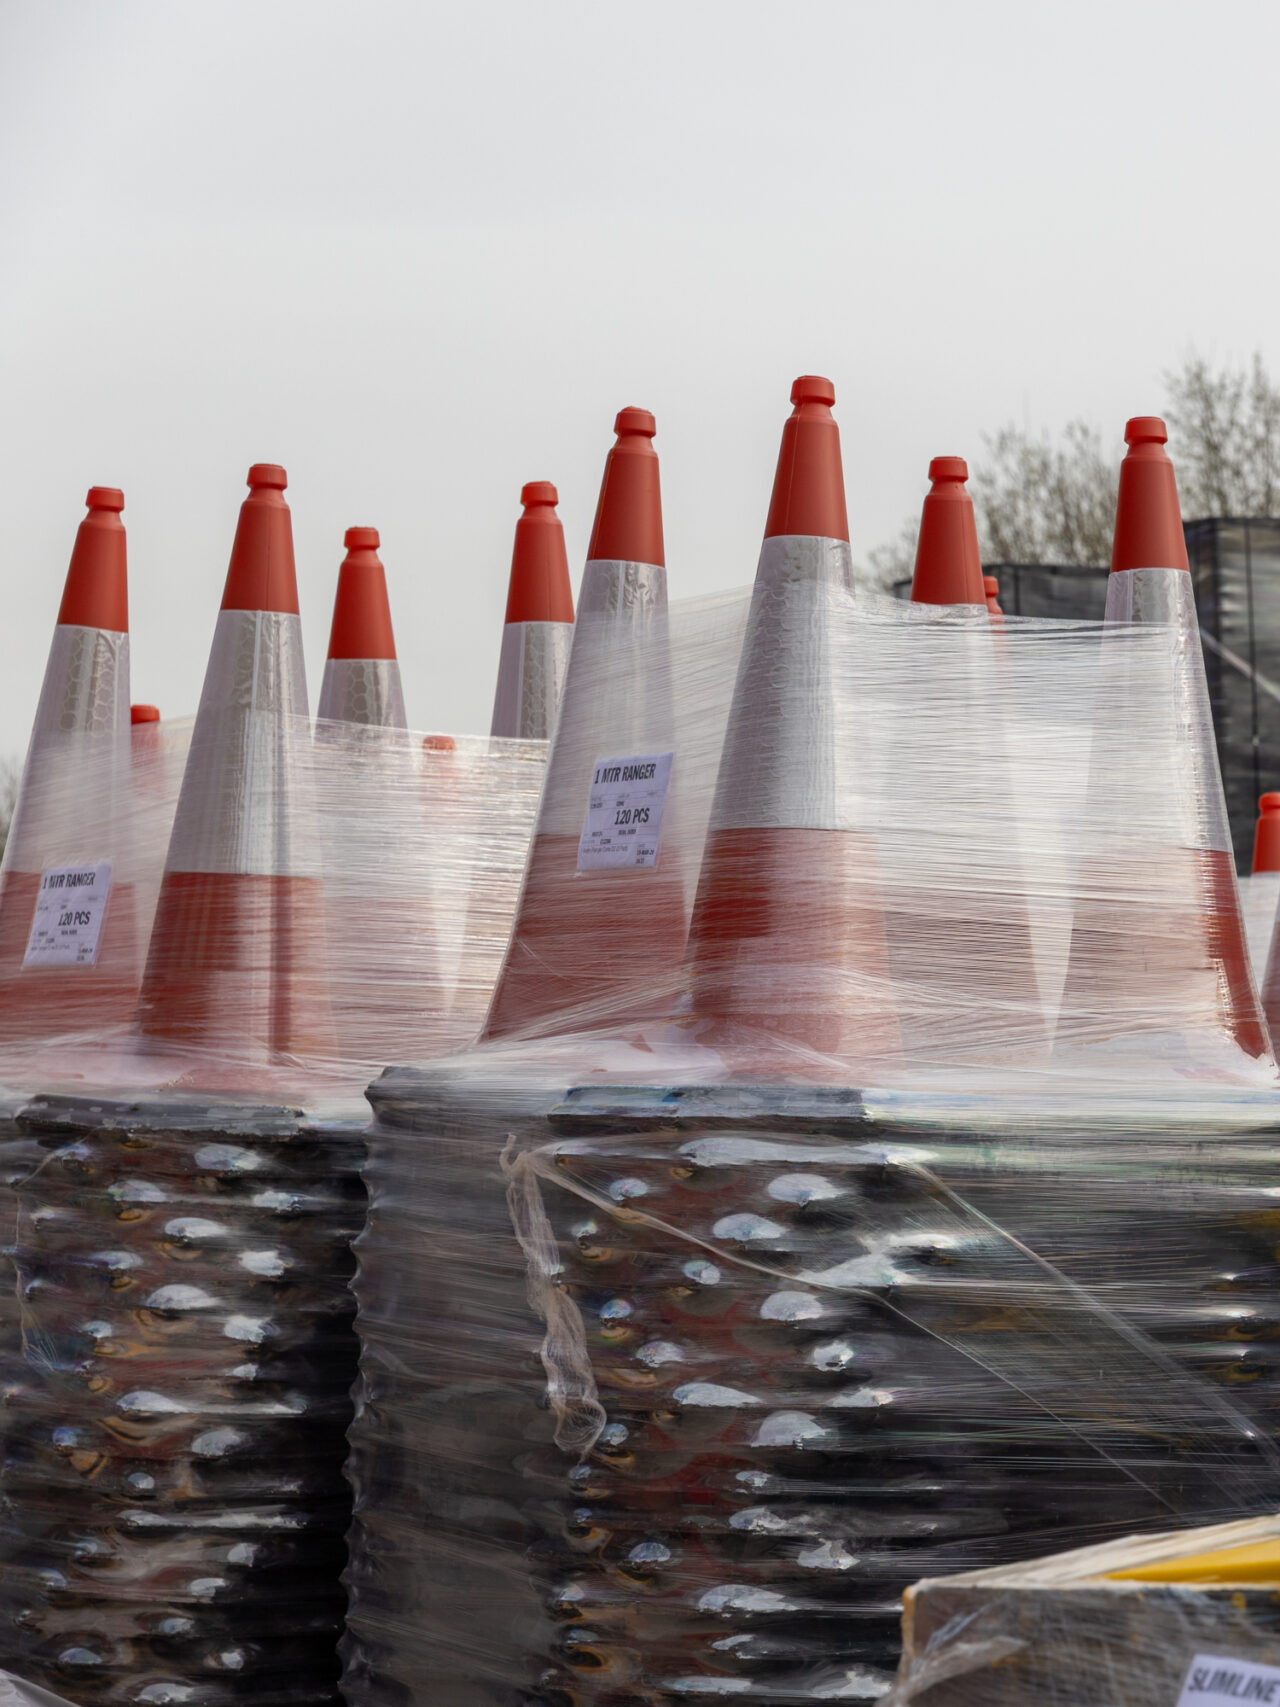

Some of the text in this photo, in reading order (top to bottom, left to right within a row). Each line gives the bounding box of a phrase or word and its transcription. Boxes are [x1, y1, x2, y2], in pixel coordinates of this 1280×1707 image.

[595, 763, 657, 784] 1 MTR RANGER
[614, 807, 650, 825] 120 PCS
[65, 872, 96, 888] RANGER
[58, 911, 91, 926] 120 PCS
